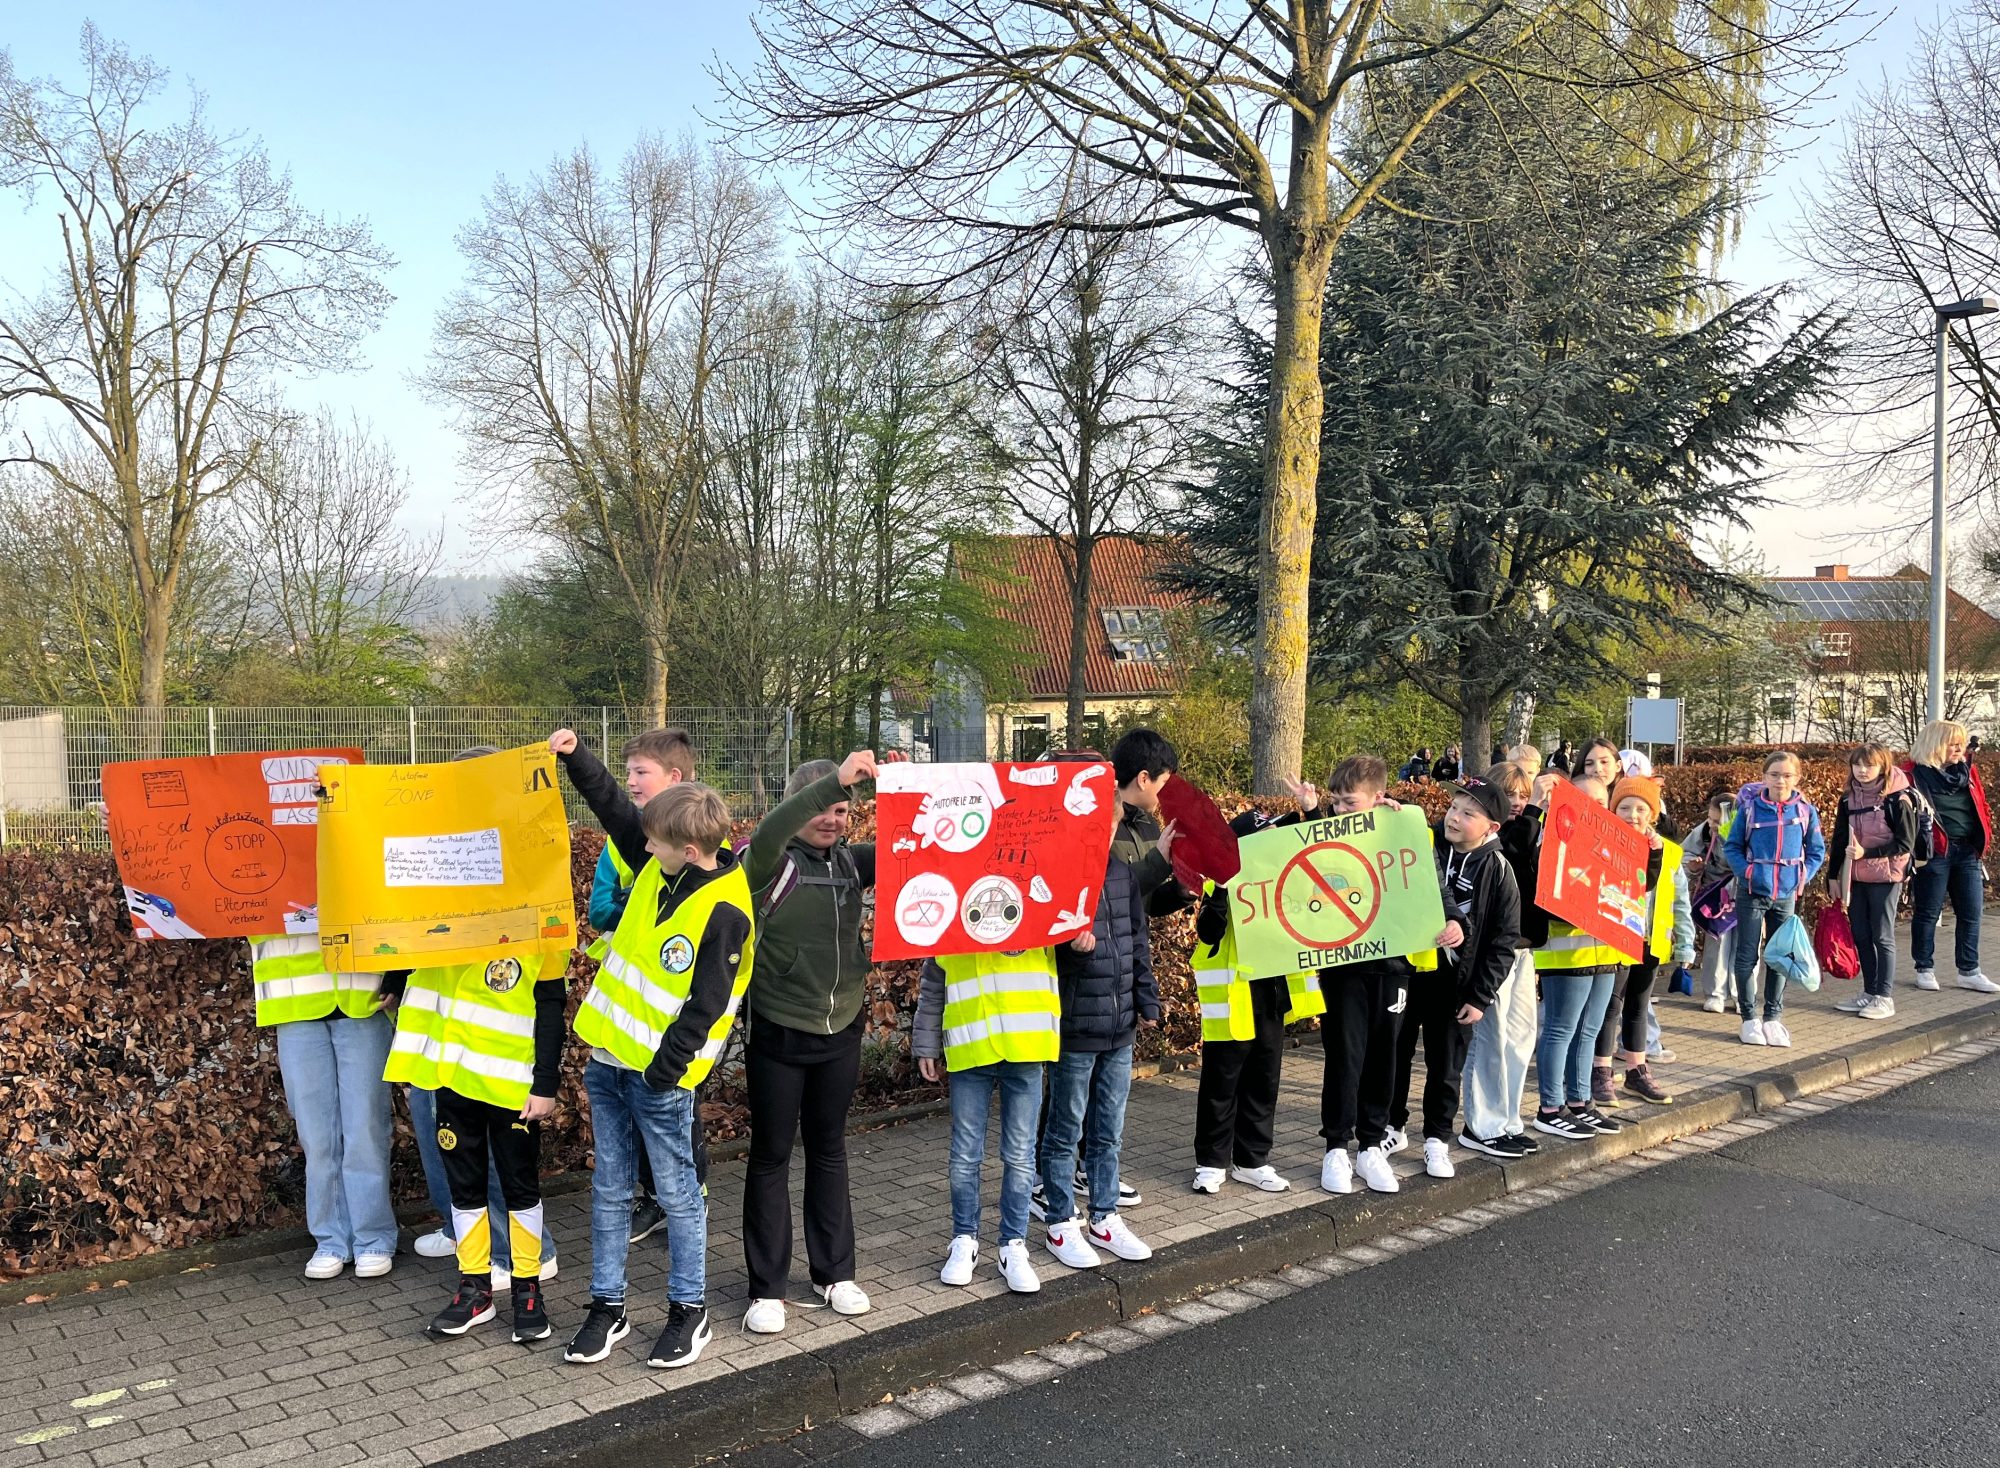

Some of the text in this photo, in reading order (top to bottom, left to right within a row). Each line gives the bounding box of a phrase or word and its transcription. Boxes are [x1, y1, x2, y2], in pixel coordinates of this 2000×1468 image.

[383, 788, 434, 807] ZONE
[1295, 811, 1376, 846] VERBOTEN
[1580, 803, 1638, 856] AUTOFREIE
[224, 833, 265, 851] STOPP
[440, 1131, 454, 1144] BVB
